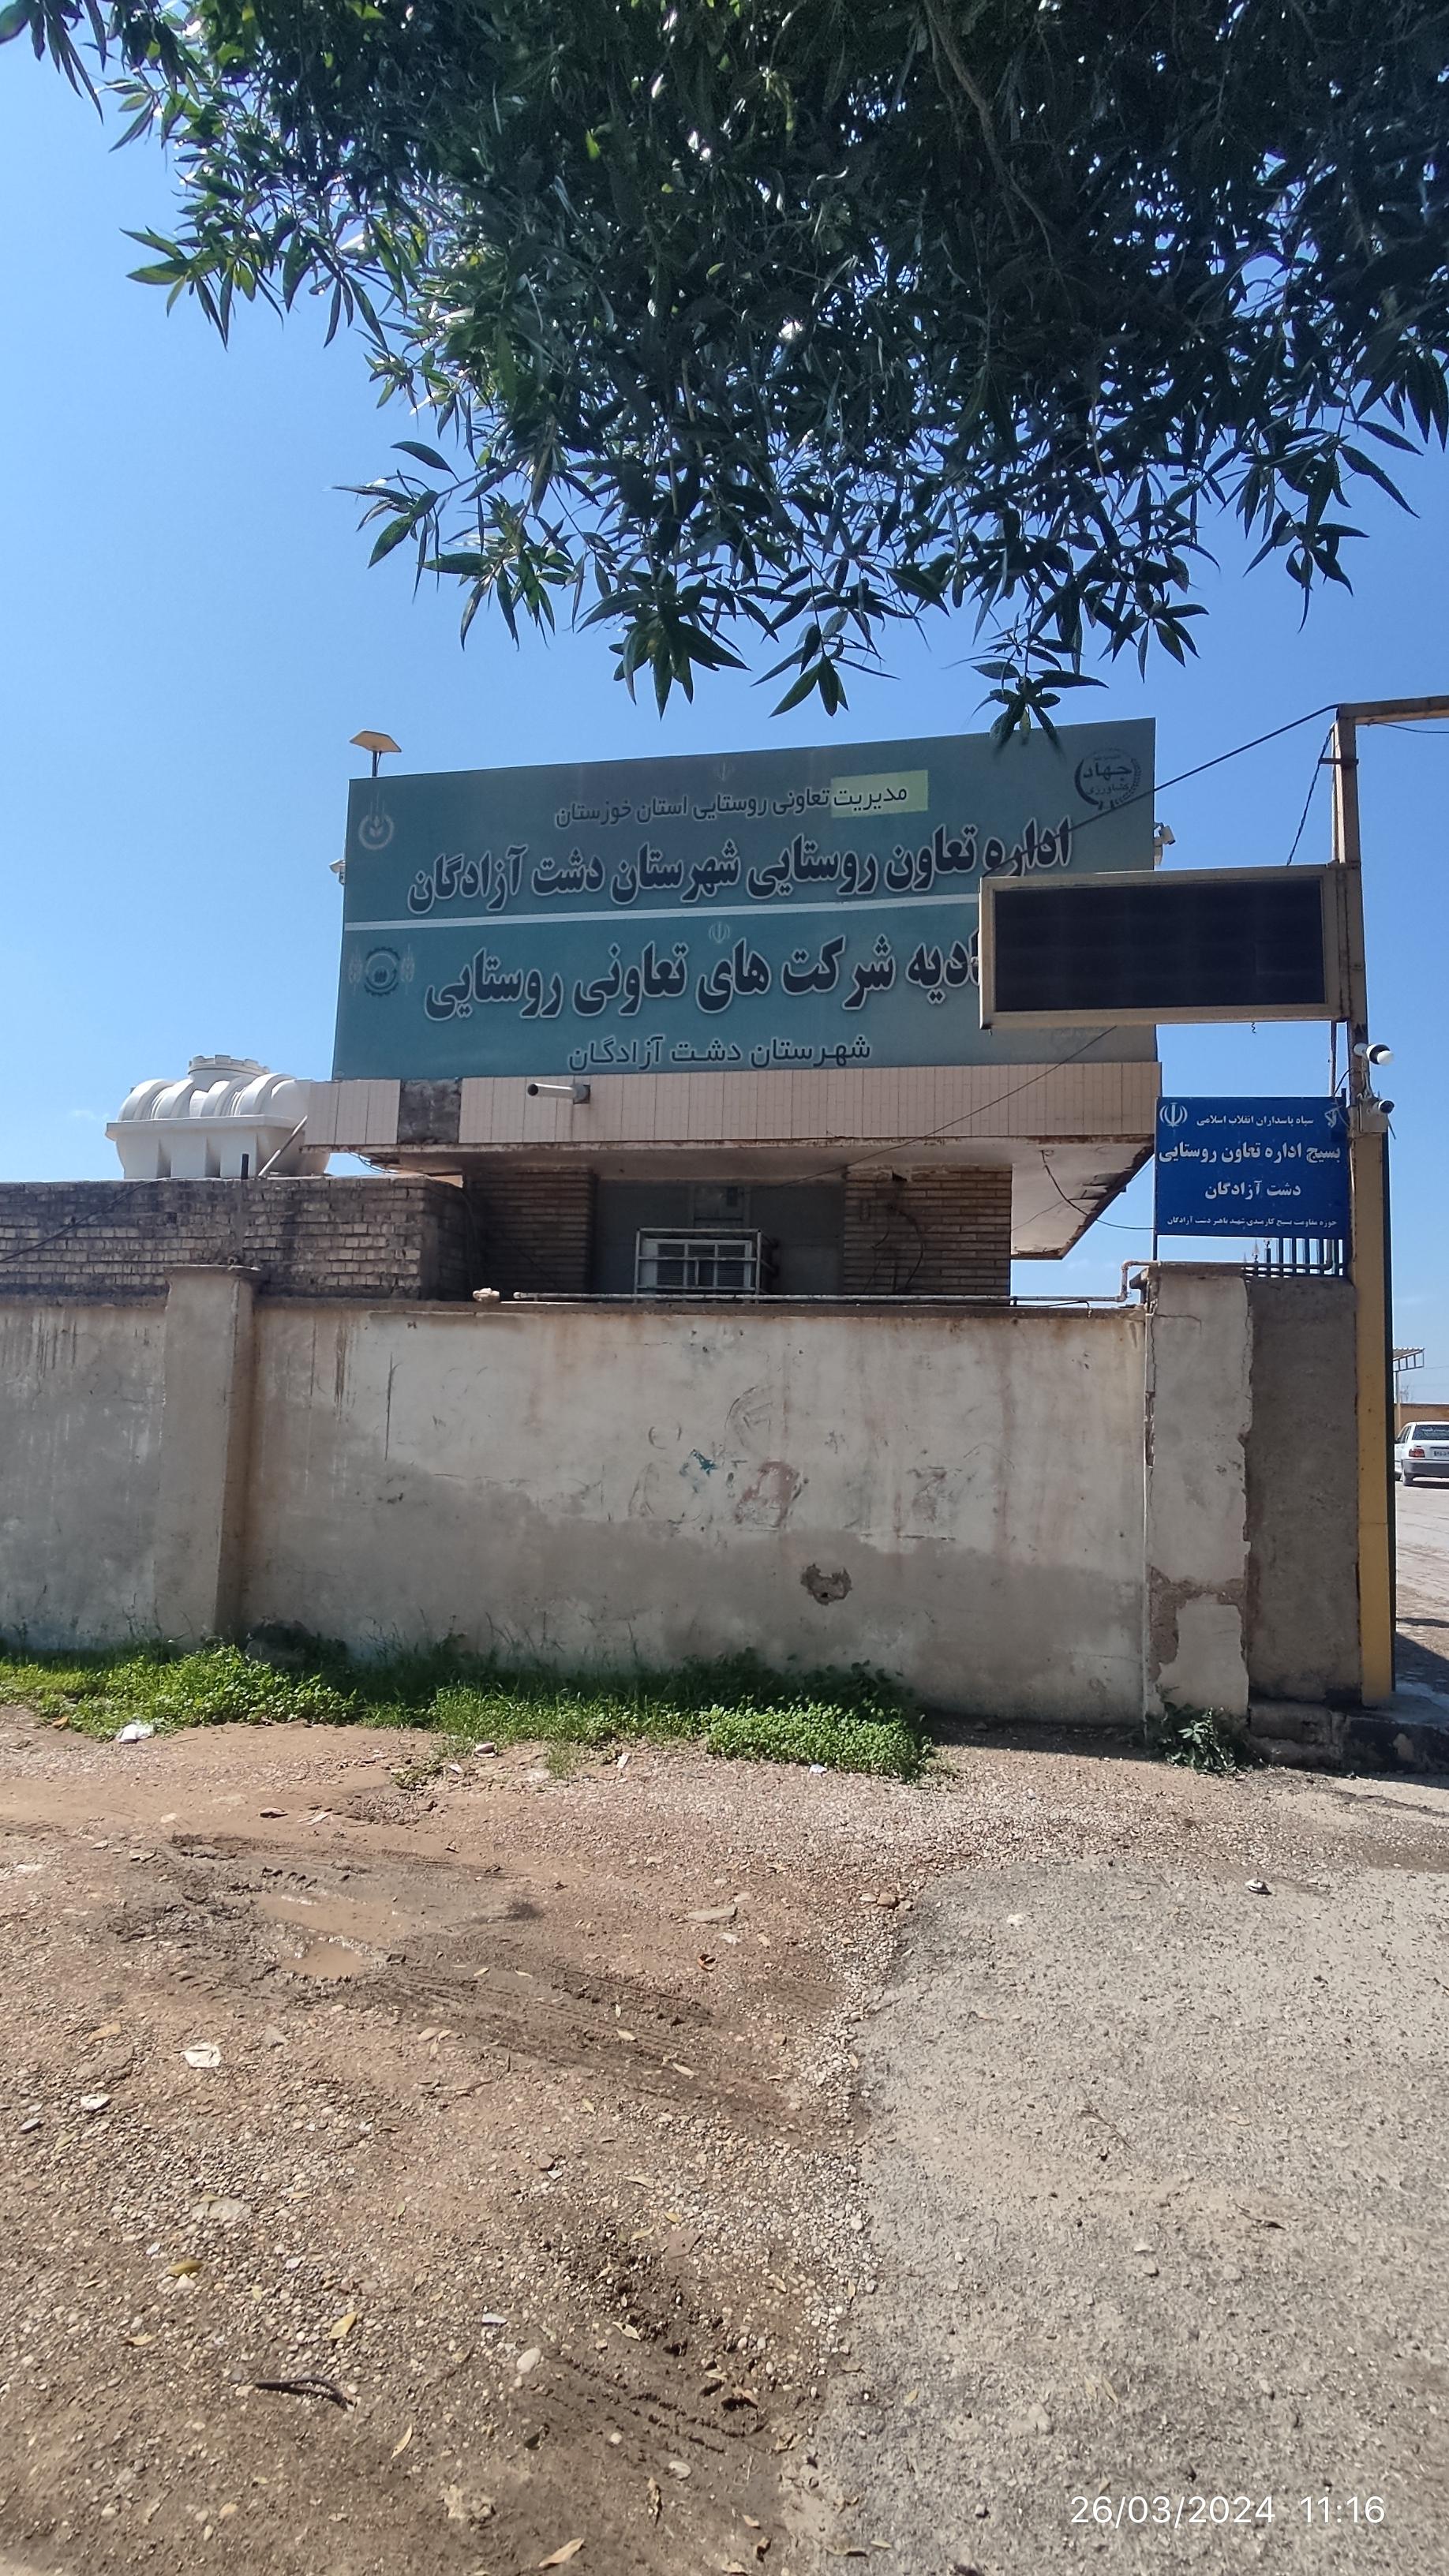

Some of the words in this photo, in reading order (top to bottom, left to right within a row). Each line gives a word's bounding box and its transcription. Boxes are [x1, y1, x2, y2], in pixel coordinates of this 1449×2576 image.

[1083, 762, 1133, 781] جهاد
[636, 794, 688, 825] استان
[692, 792, 767, 822] روستایی
[772, 787, 829, 818] تعاونی
[833, 784, 908, 812] مدیریت
[556, 800, 632, 829] خوزستان
[883, 823, 978, 893] تعاون
[982, 815, 1074, 878] اداره
[407, 844, 528, 914] آزادگان
[532, 847, 605, 897] دشت
[610, 837, 741, 904] شهرستان
[747, 833, 877, 900] روستایی
[425, 947, 564, 1021] روستایی
[572, 942, 688, 1017] تعاونی
[695, 937, 771, 1014] های
[780, 933, 895, 1010] شرکت
[567, 1035, 665, 1073] آزادگان
[670, 1037, 741, 1065] دشت
[750, 1033, 871, 1069] شهرستان
[1196, 1114, 1226, 1126] اسلامی
[1228, 1114, 1254, 1126] انقلاب
[1158, 1141, 1217, 1163] روستایی
[1221, 1142, 1262, 1163] تعاون
[1264, 1142, 1302, 1163] اداره
[1306, 1144, 1341, 1163] بسیج
[1266, 1181, 1301, 1197] دشت
